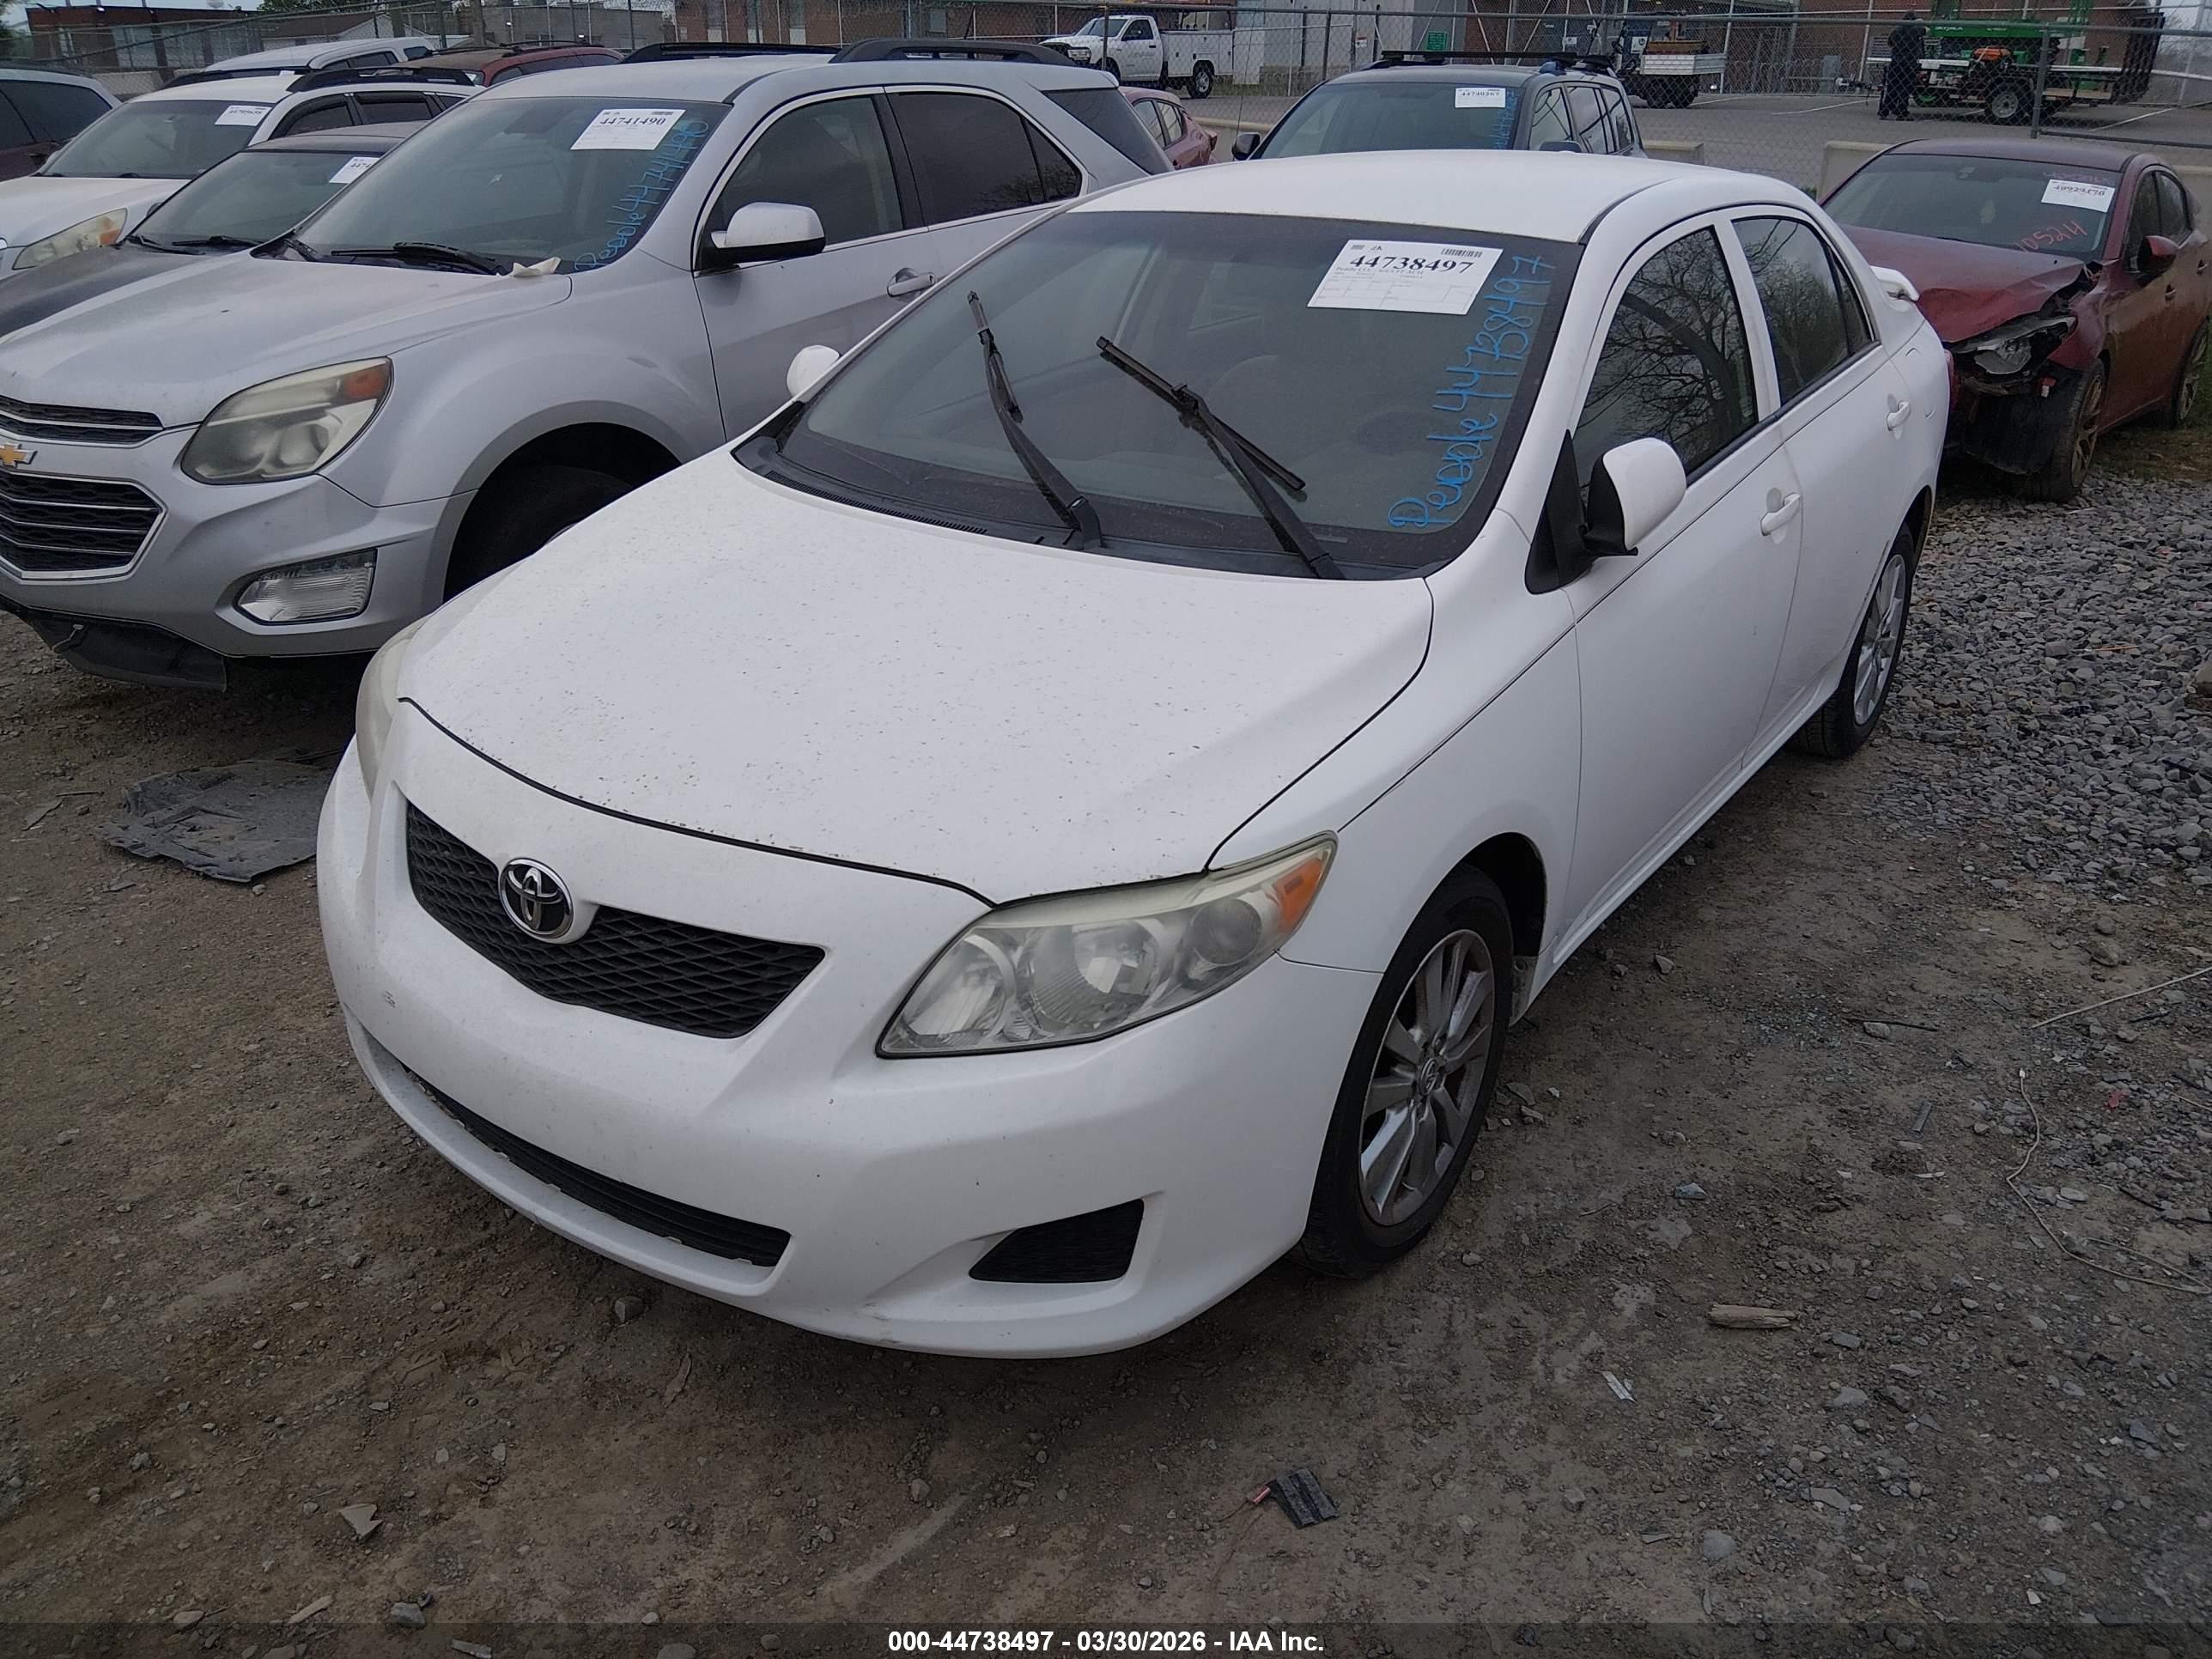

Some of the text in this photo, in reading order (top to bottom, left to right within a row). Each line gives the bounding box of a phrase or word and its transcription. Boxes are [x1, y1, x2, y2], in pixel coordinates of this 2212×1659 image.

[600, 117, 666, 125] 44741490
[1350, 255, 1475, 274] 44738497
[1432, 254, 1557, 411] 44738497
